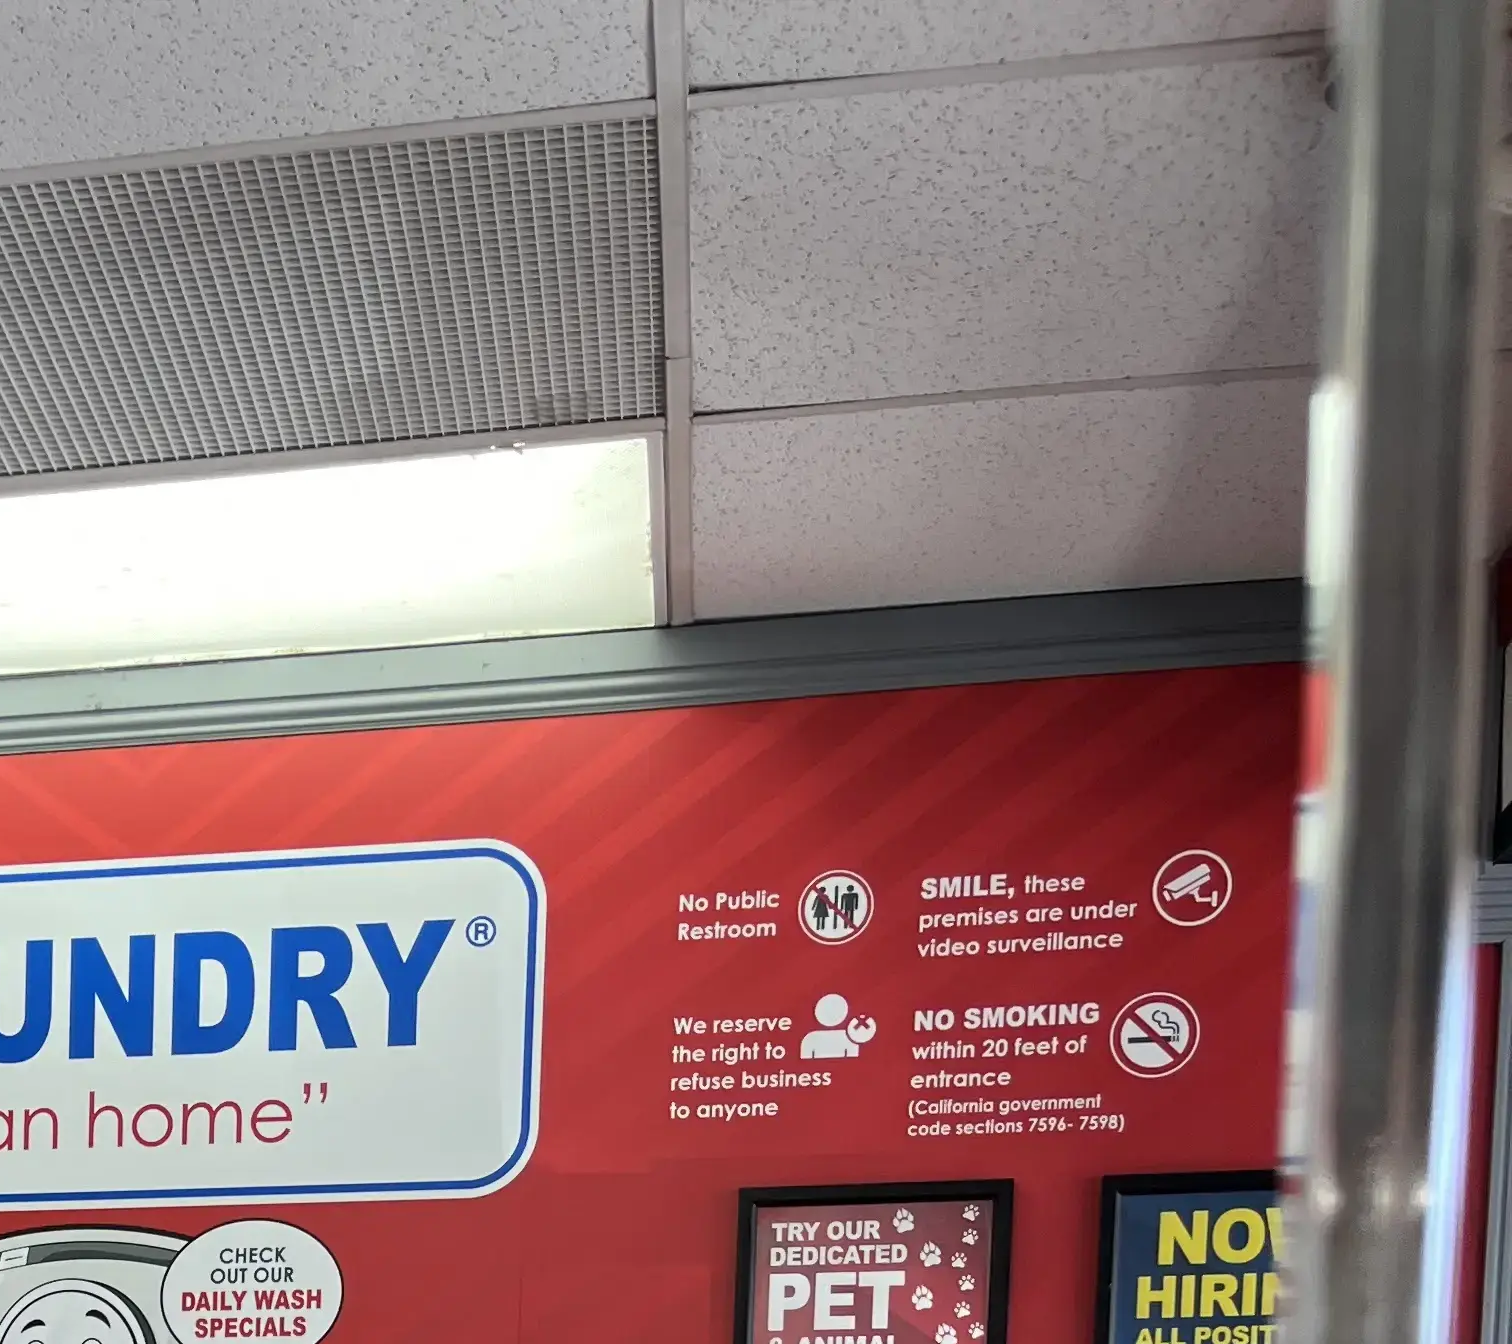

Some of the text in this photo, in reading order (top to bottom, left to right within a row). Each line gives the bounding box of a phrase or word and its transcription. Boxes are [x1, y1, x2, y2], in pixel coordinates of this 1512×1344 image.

[920, 873, 1085, 899] SMILE, these
[679, 889, 779, 912] No Public
[919, 900, 1137, 933] premises are under
[677, 921, 776, 940] Restroom
[917, 931, 1123, 957] video surveillance
[673, 1017, 792, 1034] We reserve
[914, 1002, 1099, 1031] NO SMOKING
[671, 1041, 785, 1065] the right to
[911, 1034, 1087, 1060] within 20 feet of
[670, 1069, 831, 1091] refuse business
[910, 1070, 1011, 1089] entrance
[669, 1101, 778, 1121] to anyone
[908, 1093, 1101, 1118] (California government
[907, 1120, 951, 1136] code
[955, 1118, 1023, 1135] sections
[1079, 1114, 1124, 1132] 7598)
[771, 1220, 880, 1242] TRY OUR
[219, 1246, 286, 1264] CHECK
[770, 1243, 907, 1266] DEDICATED
[210, 1266, 293, 1284] OUT OUR
[181, 1289, 321, 1311] DAILY WASH
[767, 1270, 905, 1331] PET
[194, 1316, 306, 1338] SPECIALS
